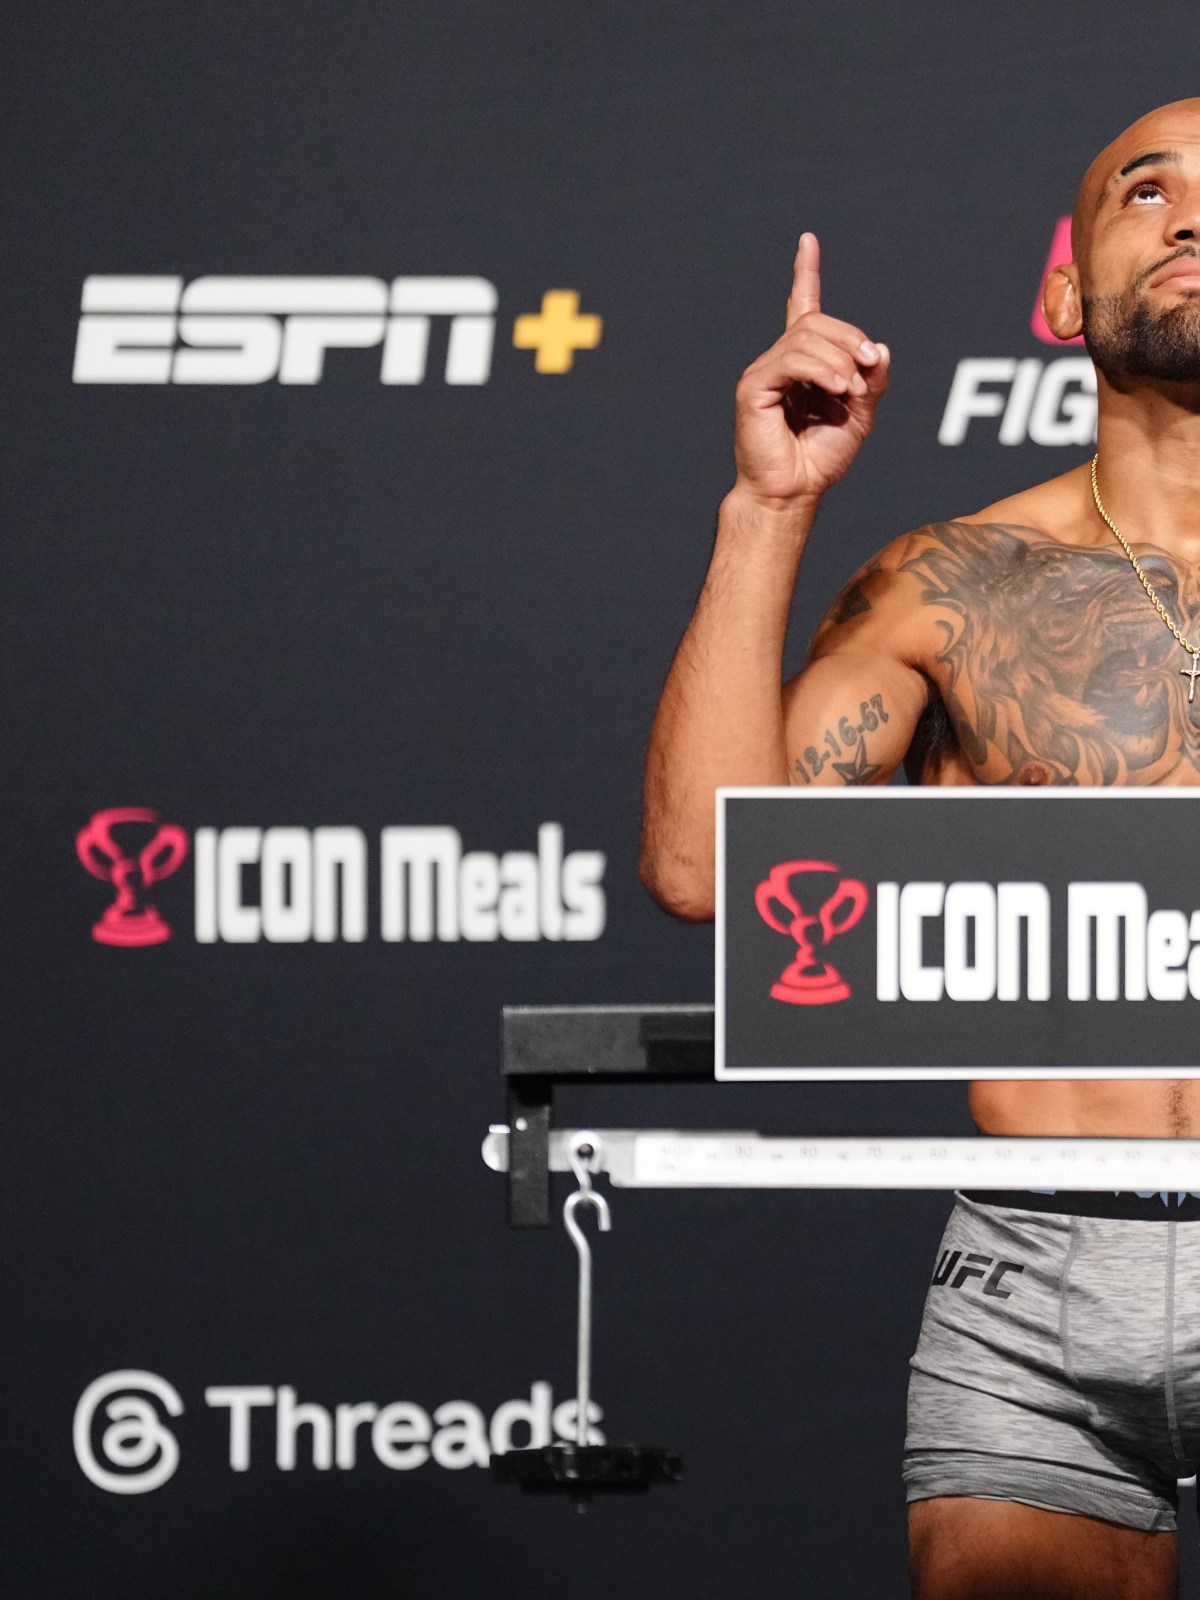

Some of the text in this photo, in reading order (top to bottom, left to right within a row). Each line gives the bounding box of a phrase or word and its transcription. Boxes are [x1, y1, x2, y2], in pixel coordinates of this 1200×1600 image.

[938, 357, 1098, 446] FIG
[795, 693, 889, 785] 12-16-67
[195, 822, 606, 943] ICON Meals
[877, 881, 1051, 1002] ICON
[931, 1249, 1025, 1300] UFC
[205, 1382, 606, 1470] Threads
